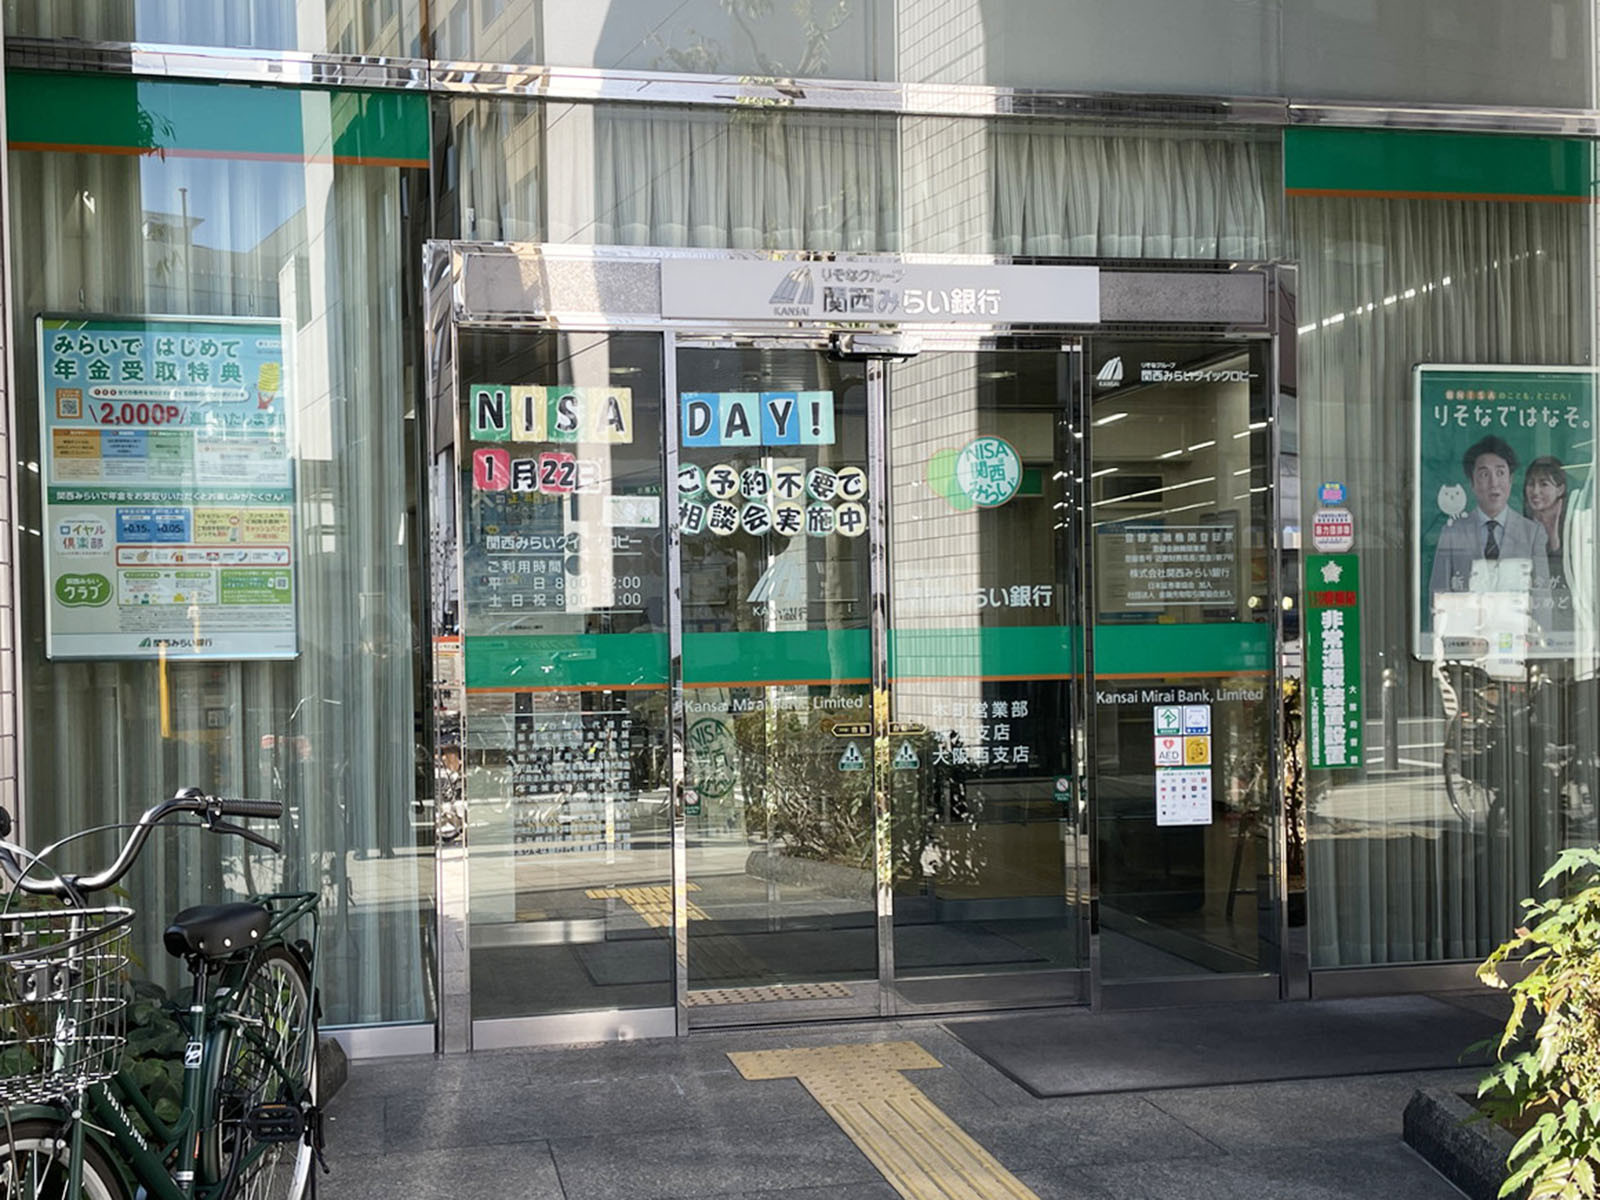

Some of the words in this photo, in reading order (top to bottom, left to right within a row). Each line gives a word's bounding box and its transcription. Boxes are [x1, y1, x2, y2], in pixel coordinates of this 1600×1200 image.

[821, 268, 905, 283] りそなグループ
[823, 286, 1002, 315] 関西みらい銀行
[774, 307, 809, 316] KANSAI
[54, 335, 143, 356] みらいで
[155, 337, 242, 358] はじめて
[53, 359, 243, 383] 年金受取特典
[1141, 370, 1258, 382] 関西みらいクイックロビー
[100, 403, 179, 425] 2,000P
[478, 391, 625, 433] NISA
[688, 401, 821, 438] DAY!
[966, 441, 1009, 461] NISA
[485, 456, 600, 491] 1月22日
[678, 468, 862, 498] ご予約不要で
[678, 502, 862, 533] 相談会実施中
[60, 525, 106, 536] ロイヤル
[486, 535, 642, 550] 関西みらいクイロビー
[488, 560, 562, 573] ご利用時間
[1129, 568, 1230, 578] 株式会社関西みらい銀行
[64, 583, 103, 599] クラブ
[813, 695, 863, 709] Limited
[1097, 691, 1138, 704] Kansai
[1142, 690, 1175, 703] Mirai
[1178, 689, 1214, 703] Bank,
[1217, 688, 1263, 701] Limited
[932, 745, 1030, 765] 大阪西支店
[1159, 751, 1179, 760] AED
